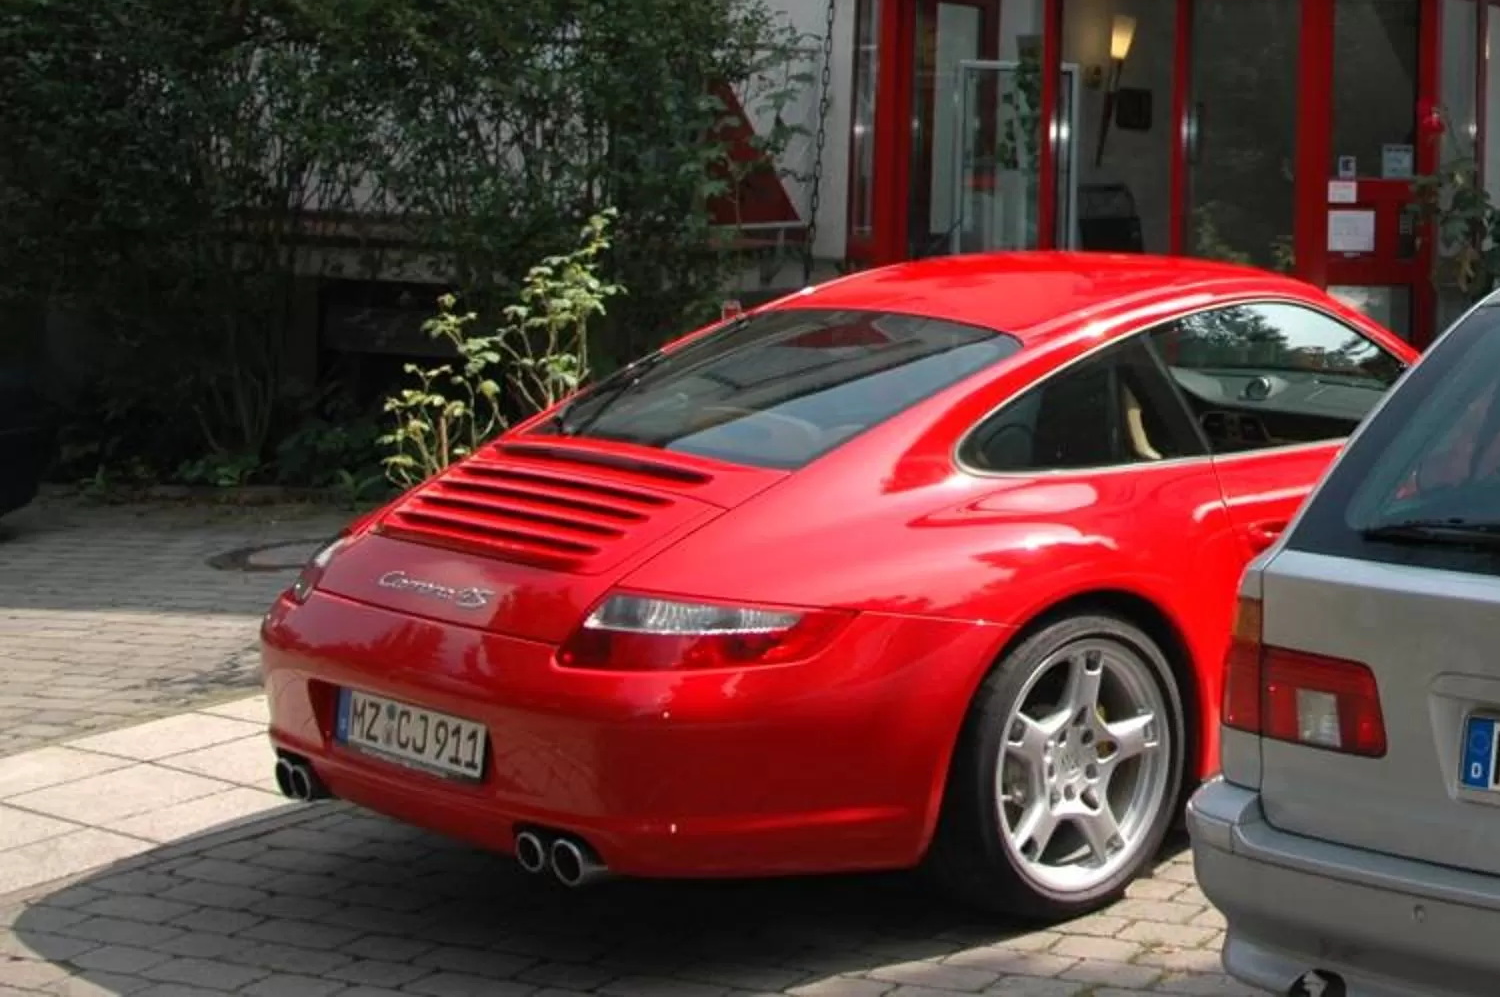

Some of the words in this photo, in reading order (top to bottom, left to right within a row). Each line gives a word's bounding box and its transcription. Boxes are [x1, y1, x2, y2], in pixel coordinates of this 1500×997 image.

[352, 698, 381, 743] MZ
[397, 710, 430, 754] CJ
[434, 720, 480, 770] 911
